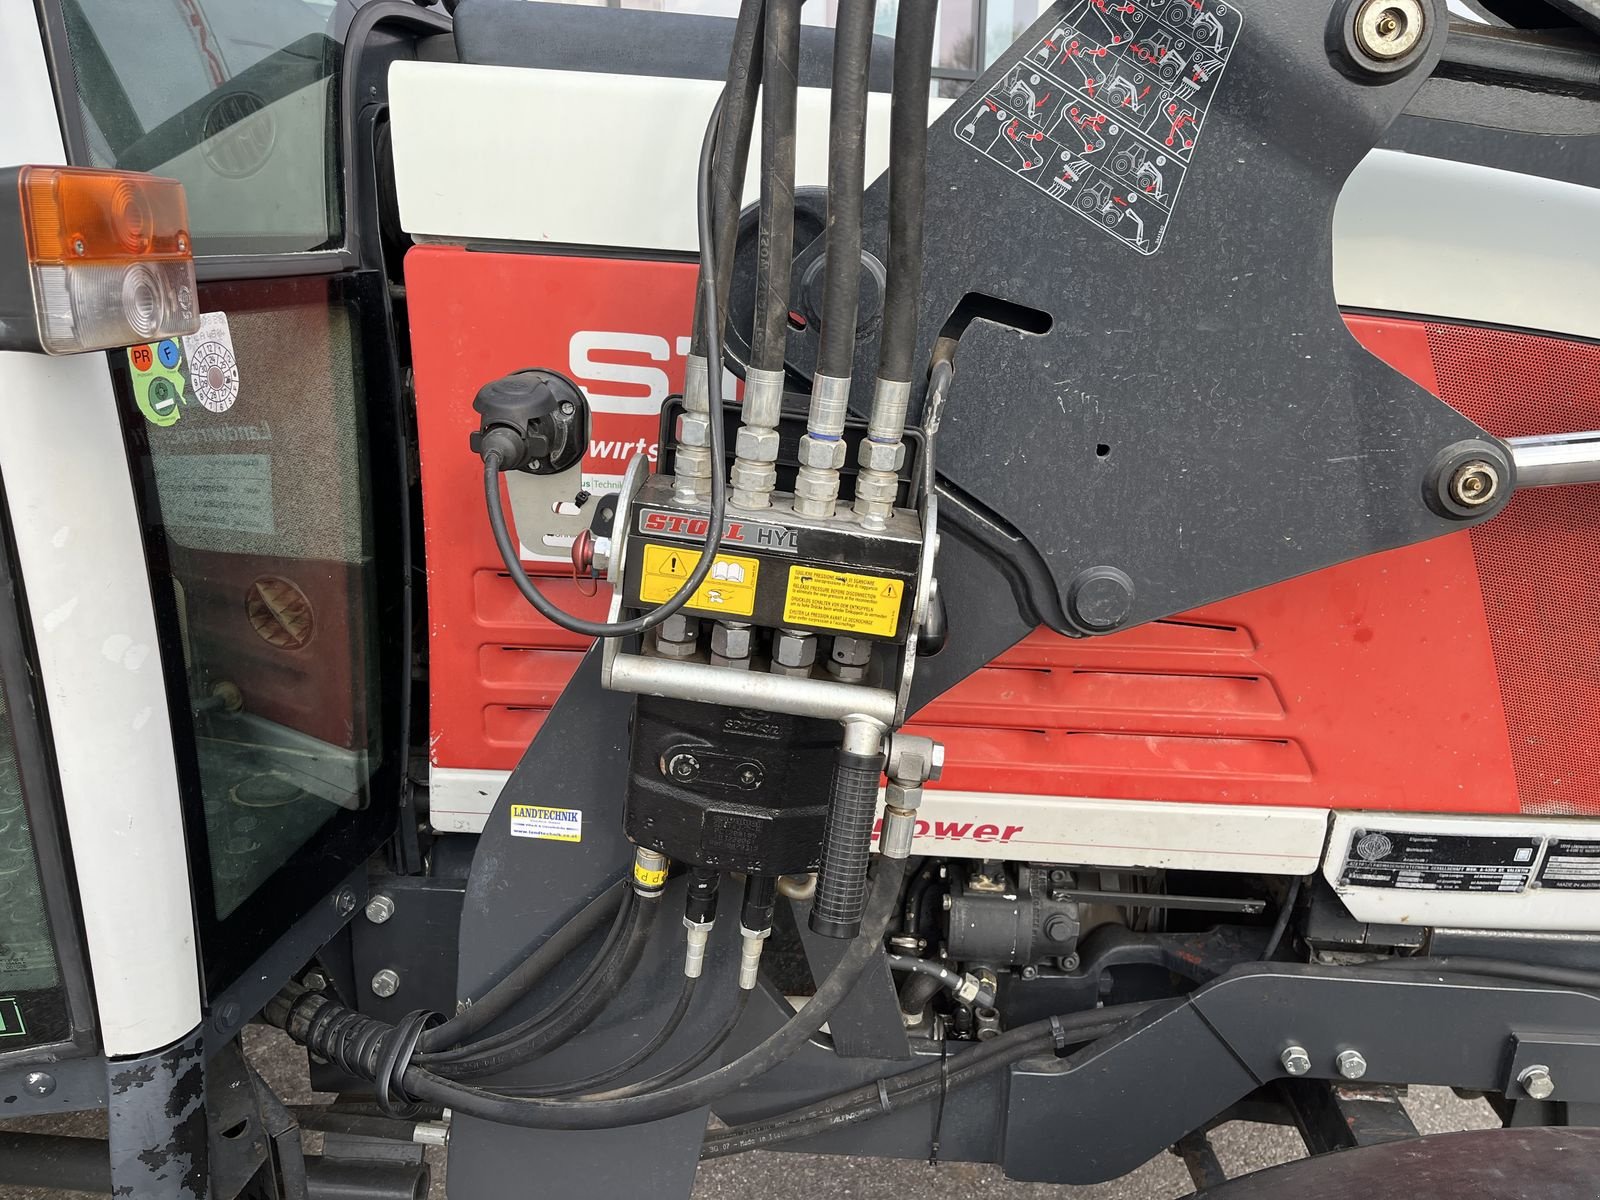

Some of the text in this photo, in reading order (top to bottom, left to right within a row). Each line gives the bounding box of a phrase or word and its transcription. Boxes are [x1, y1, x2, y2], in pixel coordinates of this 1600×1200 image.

[134, 350, 150, 364] PR
[164, 346, 171, 360] F
[645, 513, 744, 541] STOL
[514, 808, 578, 822] LANDTECHNIK
